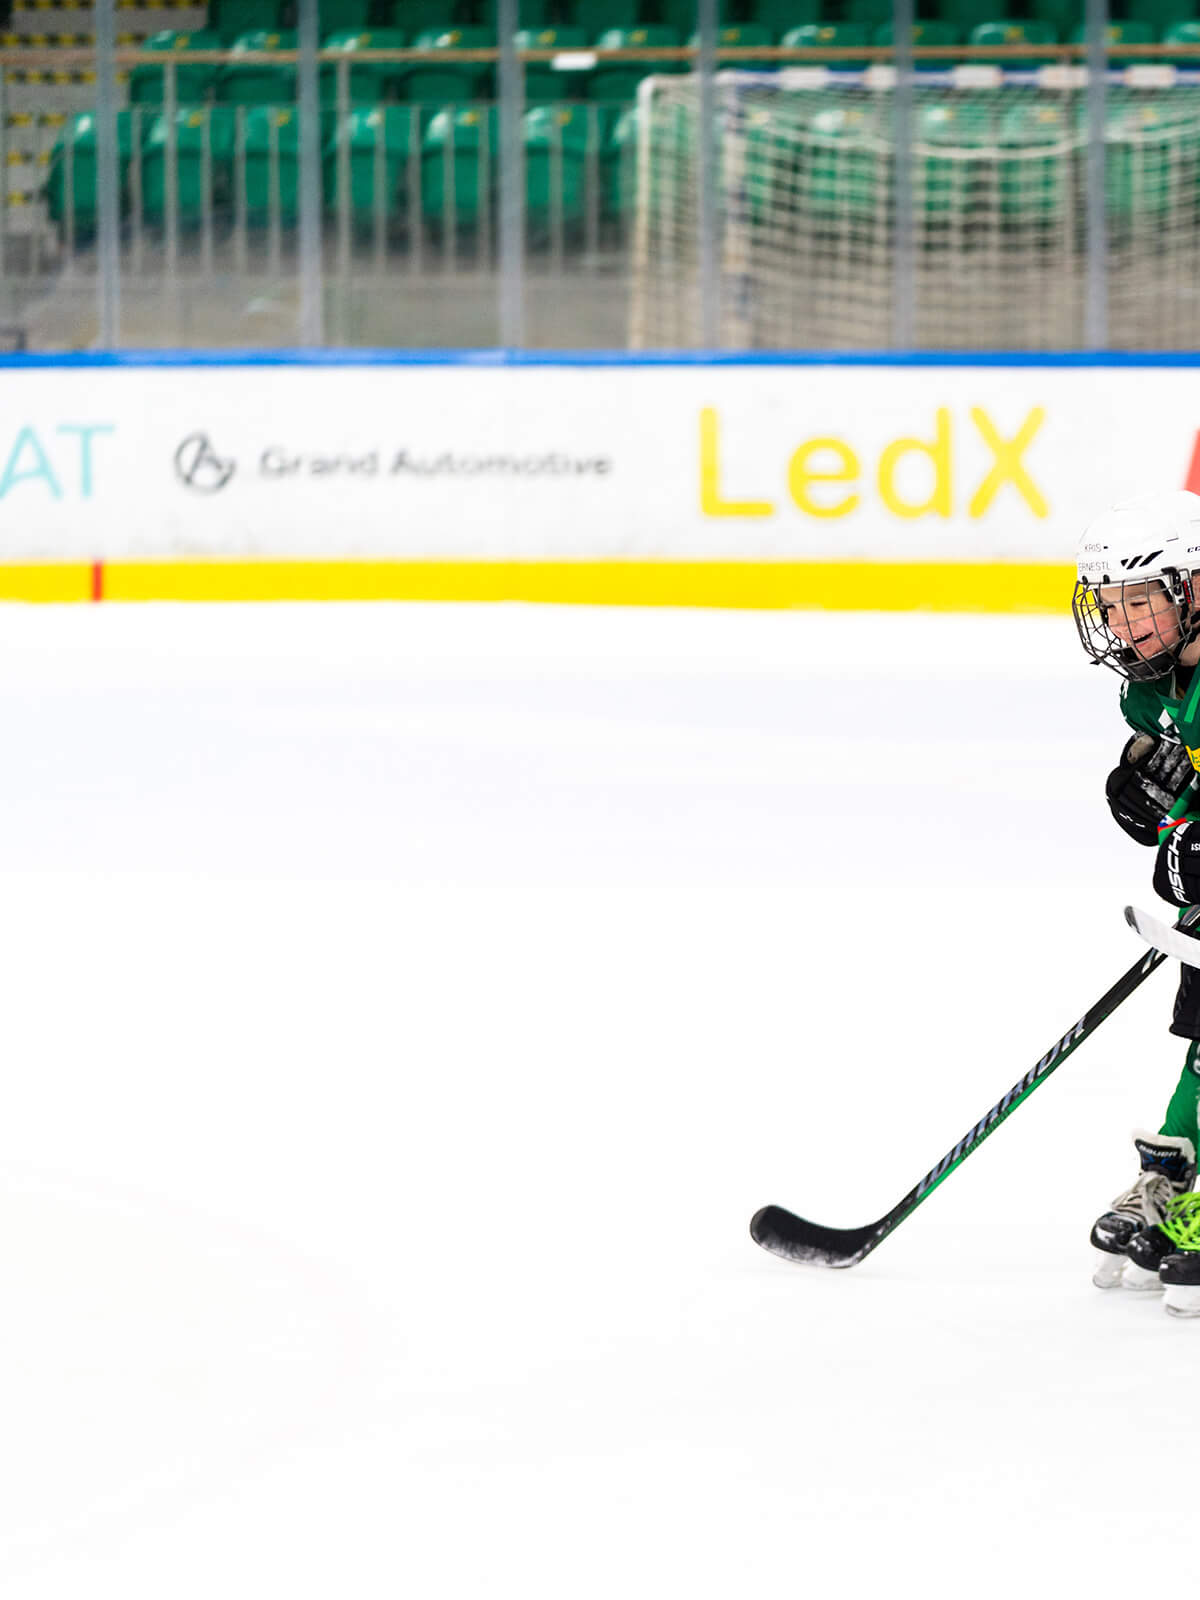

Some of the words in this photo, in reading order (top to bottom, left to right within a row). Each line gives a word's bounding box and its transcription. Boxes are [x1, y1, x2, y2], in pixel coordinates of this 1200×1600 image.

[0, 424, 115, 499] AT
[259, 447, 379, 478] Grand
[389, 447, 613, 478] Automotive
[699, 406, 1049, 519] LedX
